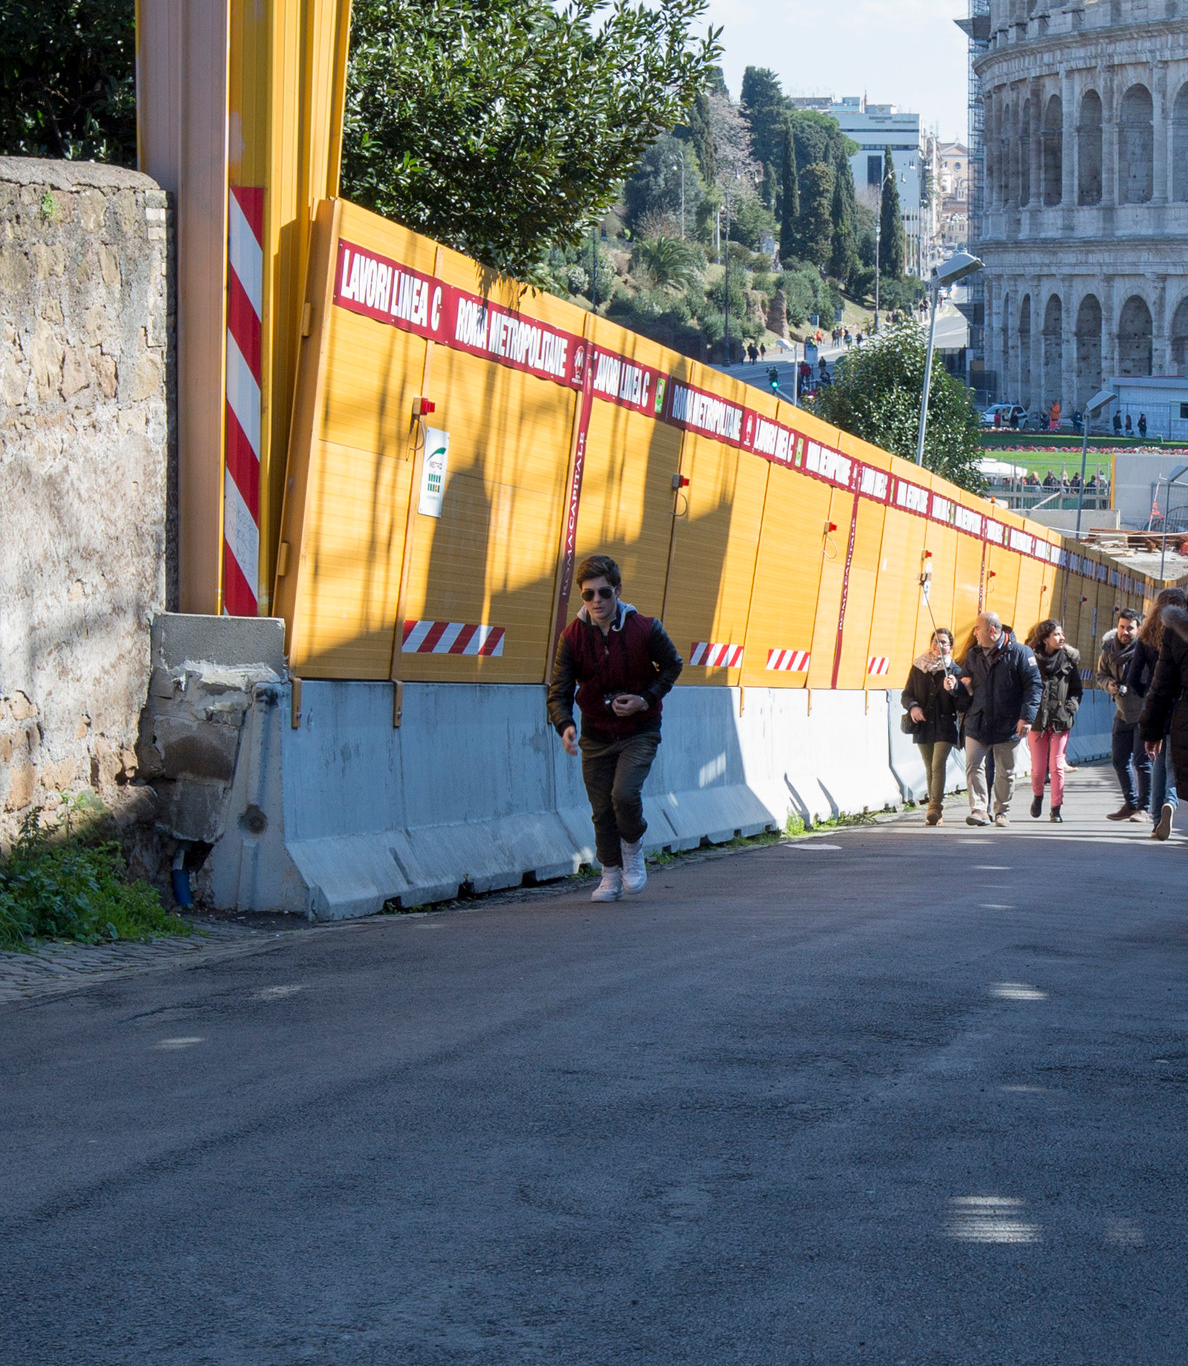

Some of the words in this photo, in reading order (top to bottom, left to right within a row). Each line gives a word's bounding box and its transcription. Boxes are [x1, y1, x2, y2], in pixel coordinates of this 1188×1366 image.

[341, 248, 393, 313] LAVORI
[390, 269, 429, 328] LINEA
[431, 286, 442, 332] C
[455, 297, 488, 350] ROMA
[488, 310, 568, 378] METROPOLITANE
[619, 362, 643, 405] LINEA
[642, 371, 650, 408] C
[692, 391, 743, 442] METROPOLITANE
[568, 430, 585, 531] CAPITALE
